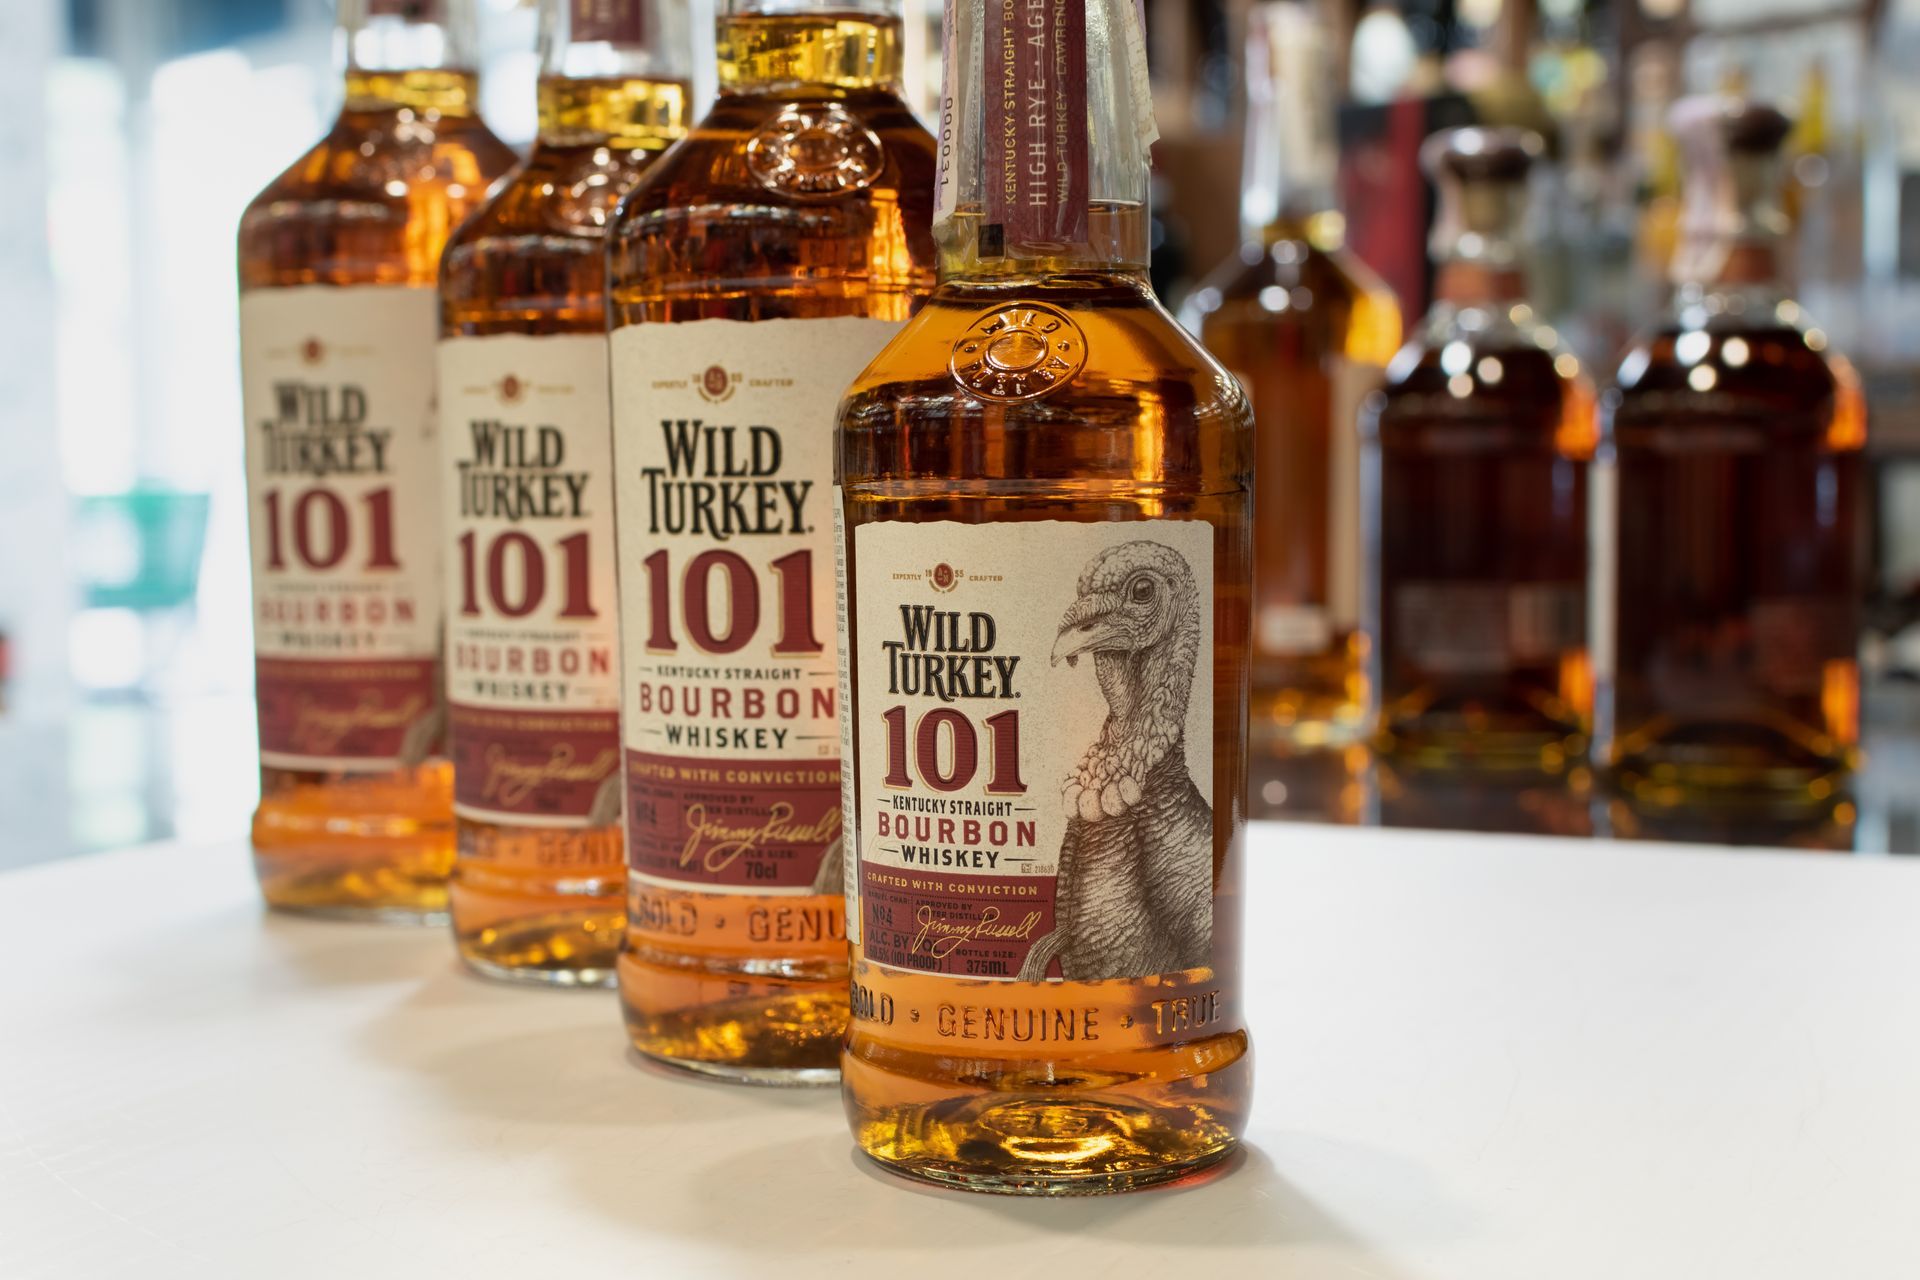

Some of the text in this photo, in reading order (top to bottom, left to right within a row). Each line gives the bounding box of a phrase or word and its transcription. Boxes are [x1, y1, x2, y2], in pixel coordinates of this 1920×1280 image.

[1003, 27, 1016, 110] STRAIGHT
[1028, 79, 1046, 128] RYE
[1055, 92, 1068, 156] TURKEY
[940, 97, 953, 186] 000031
[1004, 116, 1016, 204] KENTUCKY
[1029, 143, 1047, 206] HIGH
[1056, 162, 1069, 204] WILD
[469, 419, 566, 469] WILD
[661, 419, 783, 478] WILD
[455, 458, 591, 523] TURKEY
[641, 467, 814, 541] TURKEY
[263, 484, 403, 574] 101
[457, 528, 601, 621] 101
[642, 548, 823, 659] 101
[899, 604, 997, 653] WILD
[657, 664, 802, 680] KENTUCKY STRAIGHT
[882, 640, 1021, 702] TURKEY
[640, 682, 835, 720] BOURBON
[666, 723, 788, 749] WHISKEY
[881, 705, 1029, 797] 101
[679, 766, 720, 782] WITH
[726, 768, 840, 785] CONVICTION
[878, 811, 1037, 848] BOURBON
[892, 795, 1013, 817] KENTUCKY STRAIGHT
[745, 861, 778, 880] 70cl
[901, 845, 1000, 869] WHISKEY
[867, 871, 1038, 896] CRAFTED WITH CONVICTION
[961, 903, 973, 911] BY
[893, 934, 909, 949] BY
[956, 948, 992, 958] BOTTLE
[936, 1003, 1100, 1042] GENUINE
[1150, 990, 1221, 1035] TRUE
